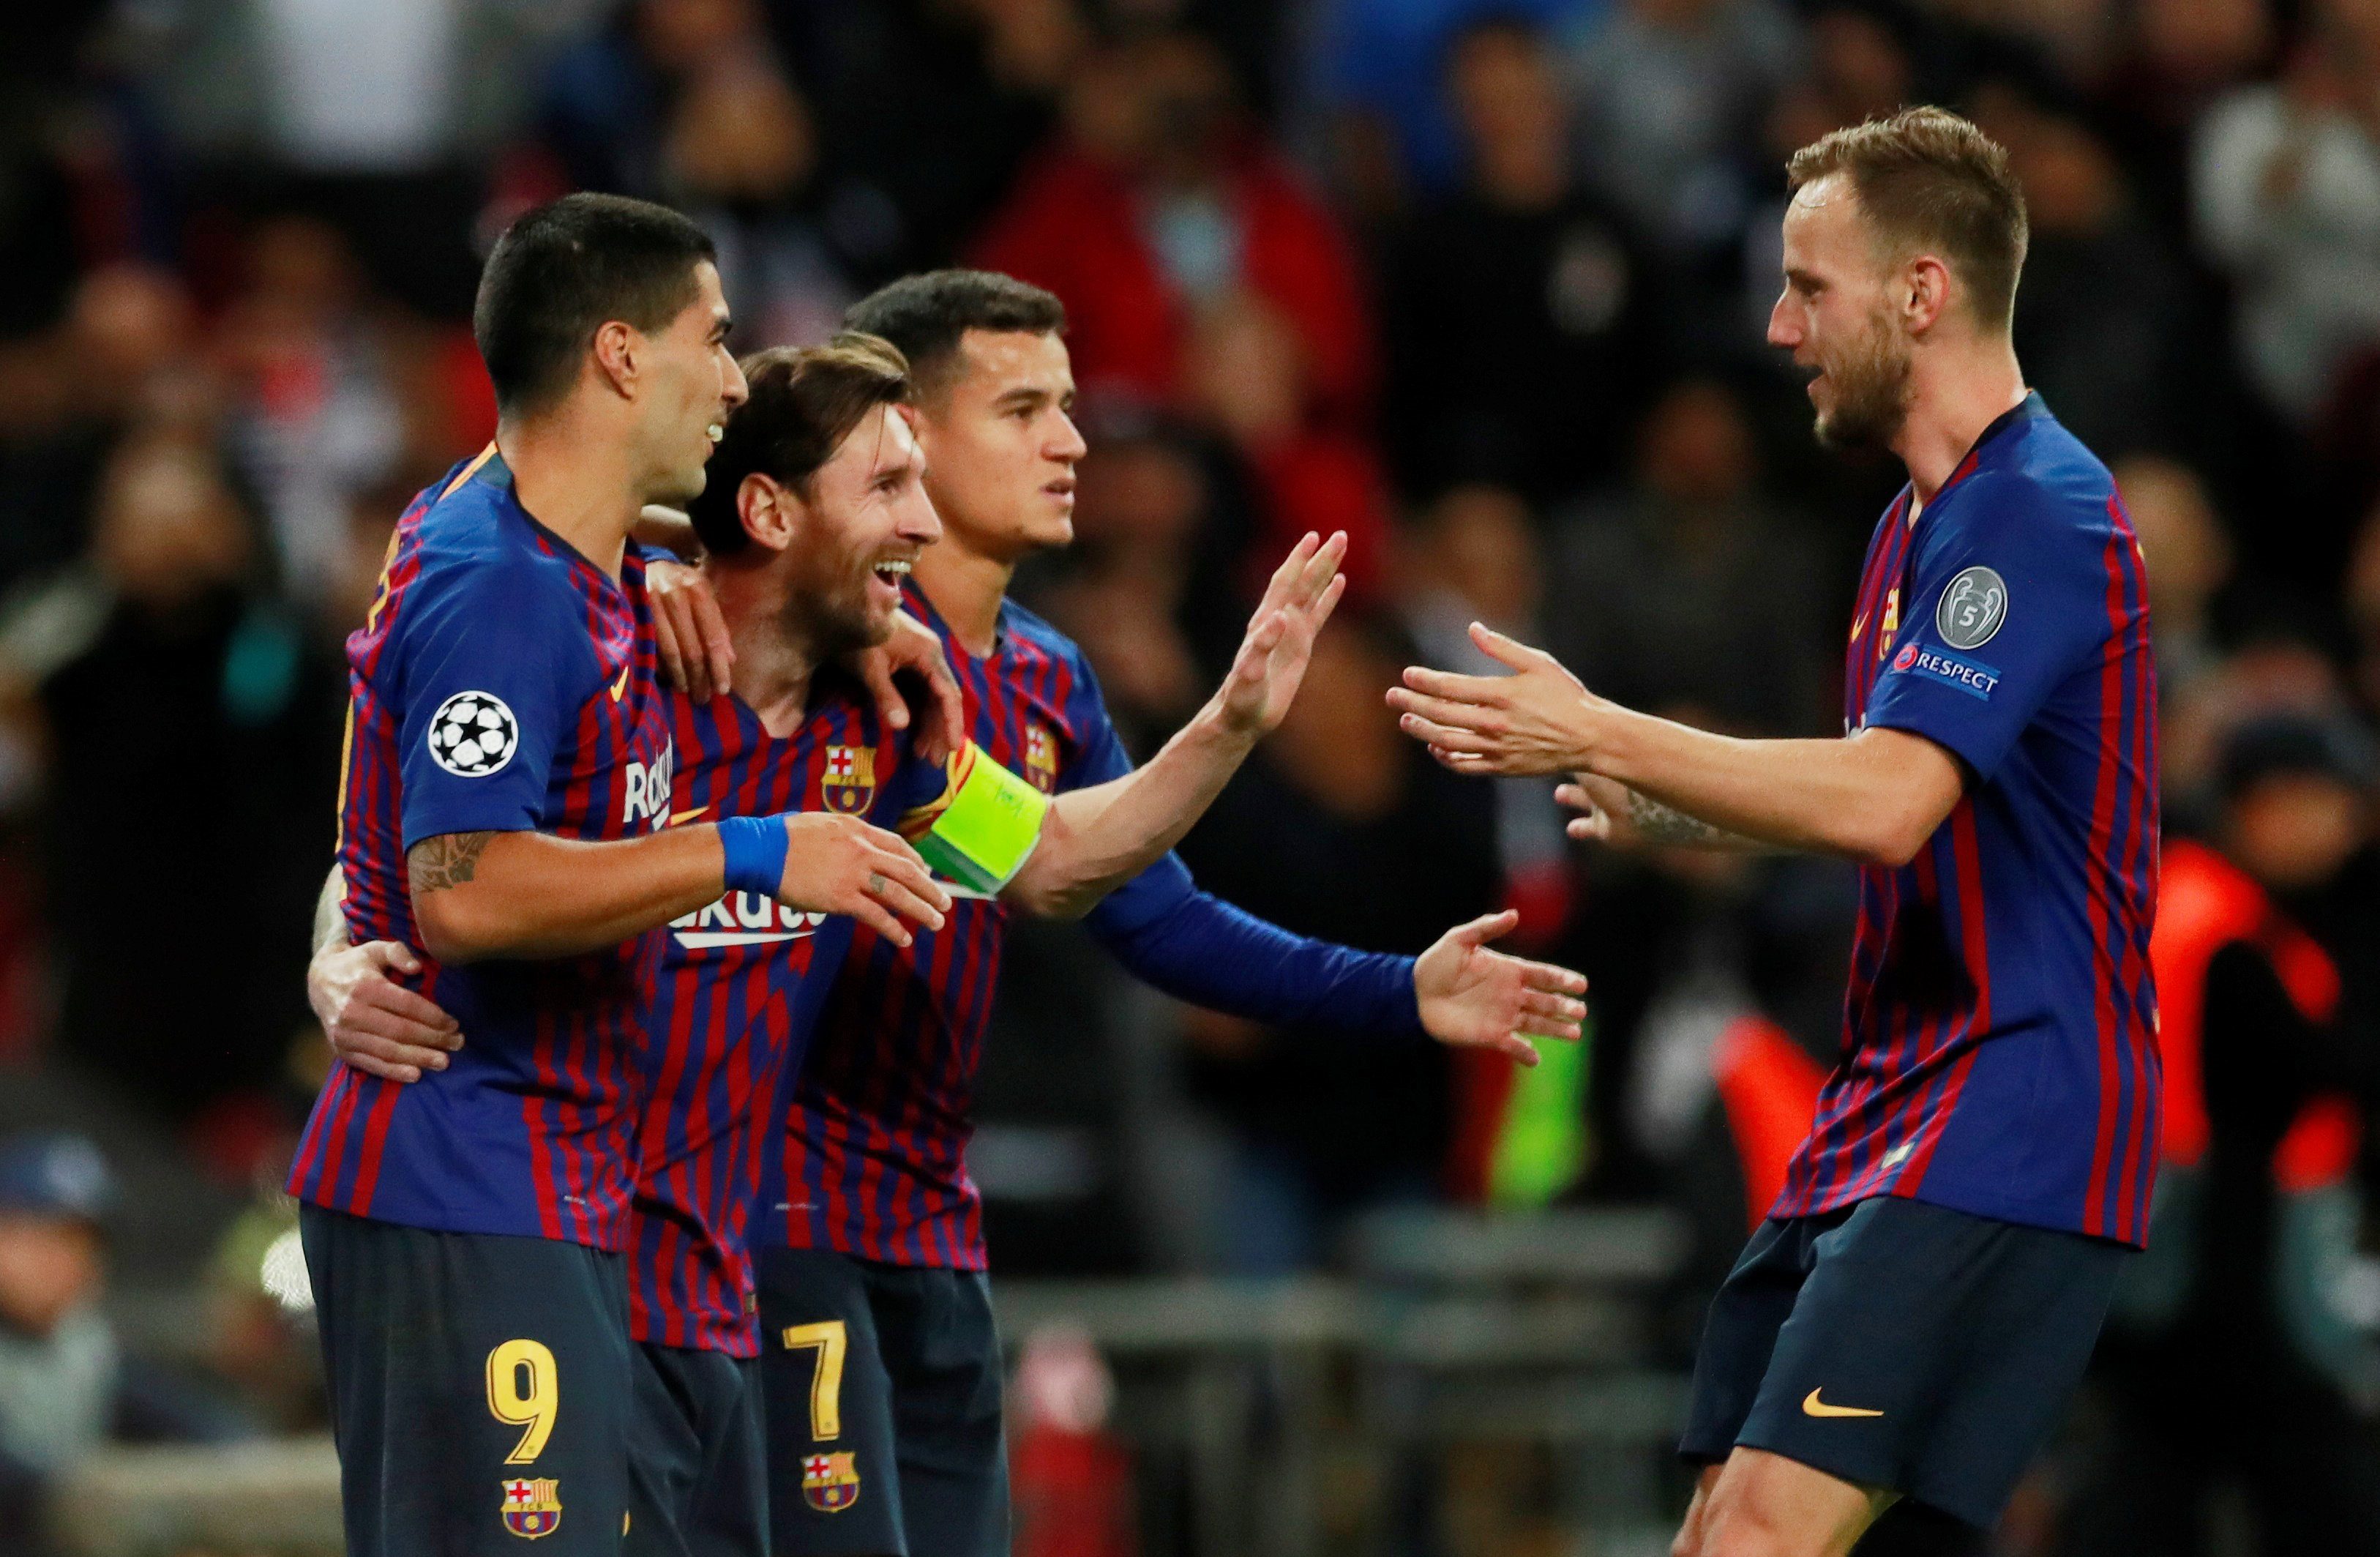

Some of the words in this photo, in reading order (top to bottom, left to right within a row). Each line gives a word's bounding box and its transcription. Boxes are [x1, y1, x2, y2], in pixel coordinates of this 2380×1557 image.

[1958, 605, 1978, 627] 5
[1916, 652, 1999, 692] RESPECT
[484, 1338, 558, 1465] 9
[782, 1320, 847, 1442] 7
